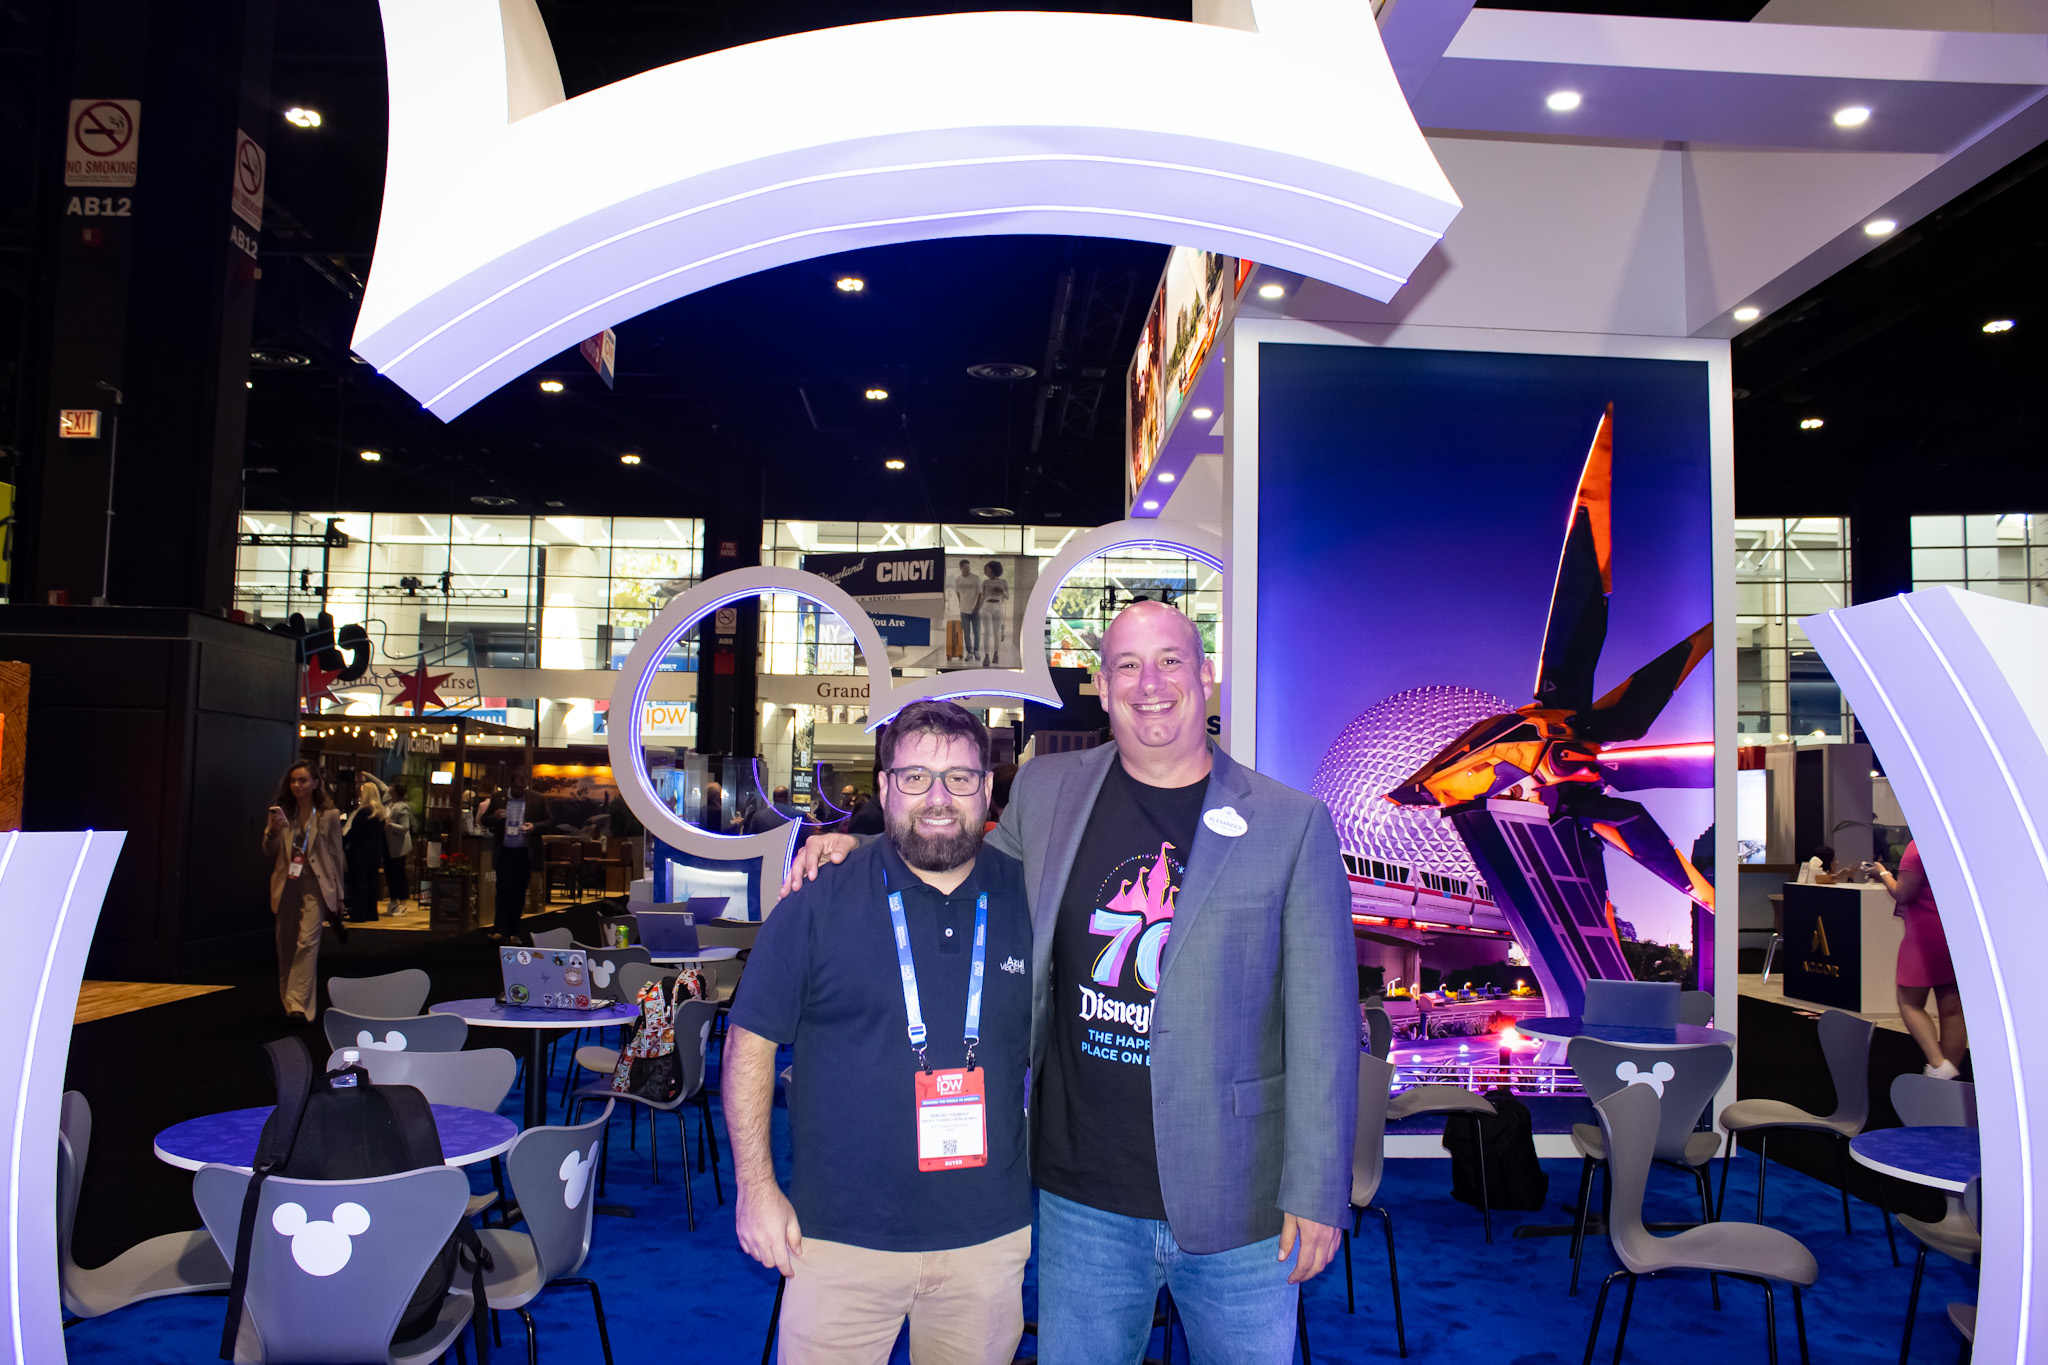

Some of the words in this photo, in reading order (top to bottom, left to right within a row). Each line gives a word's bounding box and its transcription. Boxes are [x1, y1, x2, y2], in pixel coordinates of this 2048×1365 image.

[67, 161, 82, 174] NO
[85, 161, 136, 174] SMOKING
[66, 196, 131, 216] AB12
[230, 224, 258, 260] AB12
[66, 411, 93, 430] EXIT
[876, 560, 929, 583] CINCY
[888, 618, 905, 627] Are
[647, 707, 688, 731] ipw
[1088, 909, 1172, 994] 70
[1006, 955, 1025, 969] Azul
[1802, 960, 1840, 977] ACCOR
[540, 971, 551, 984] hp
[1088, 1029, 1114, 1045] THE
[1081, 1041, 1118, 1061] PLACE
[1121, 1051, 1143, 1065] ON
[936, 1078, 963, 1096] ipw
